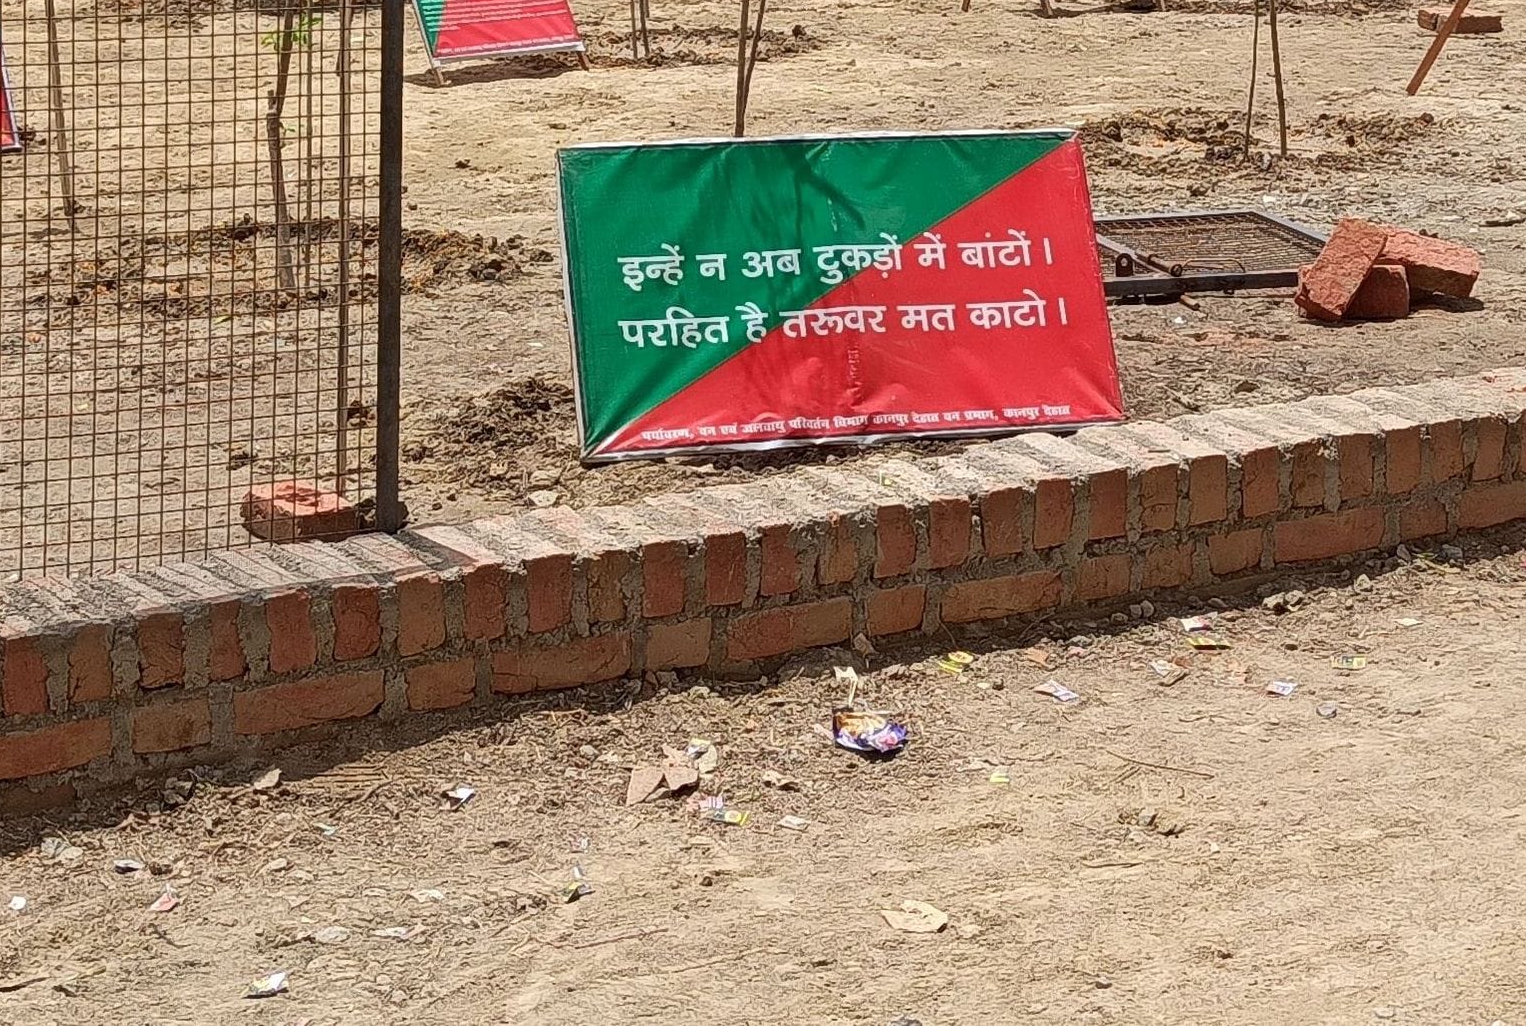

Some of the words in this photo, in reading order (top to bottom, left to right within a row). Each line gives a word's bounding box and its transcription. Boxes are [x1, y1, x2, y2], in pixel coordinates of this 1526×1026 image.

[617, 242, 685, 292] इन्हें
[695, 252, 727, 281] न
[741, 248, 801, 278] अब
[812, 231, 903, 285] टुकड़ों
[913, 231, 947, 270] में
[617, 305, 730, 349] परहित
[735, 301, 769, 344] है
[896, 303, 956, 332] मत
